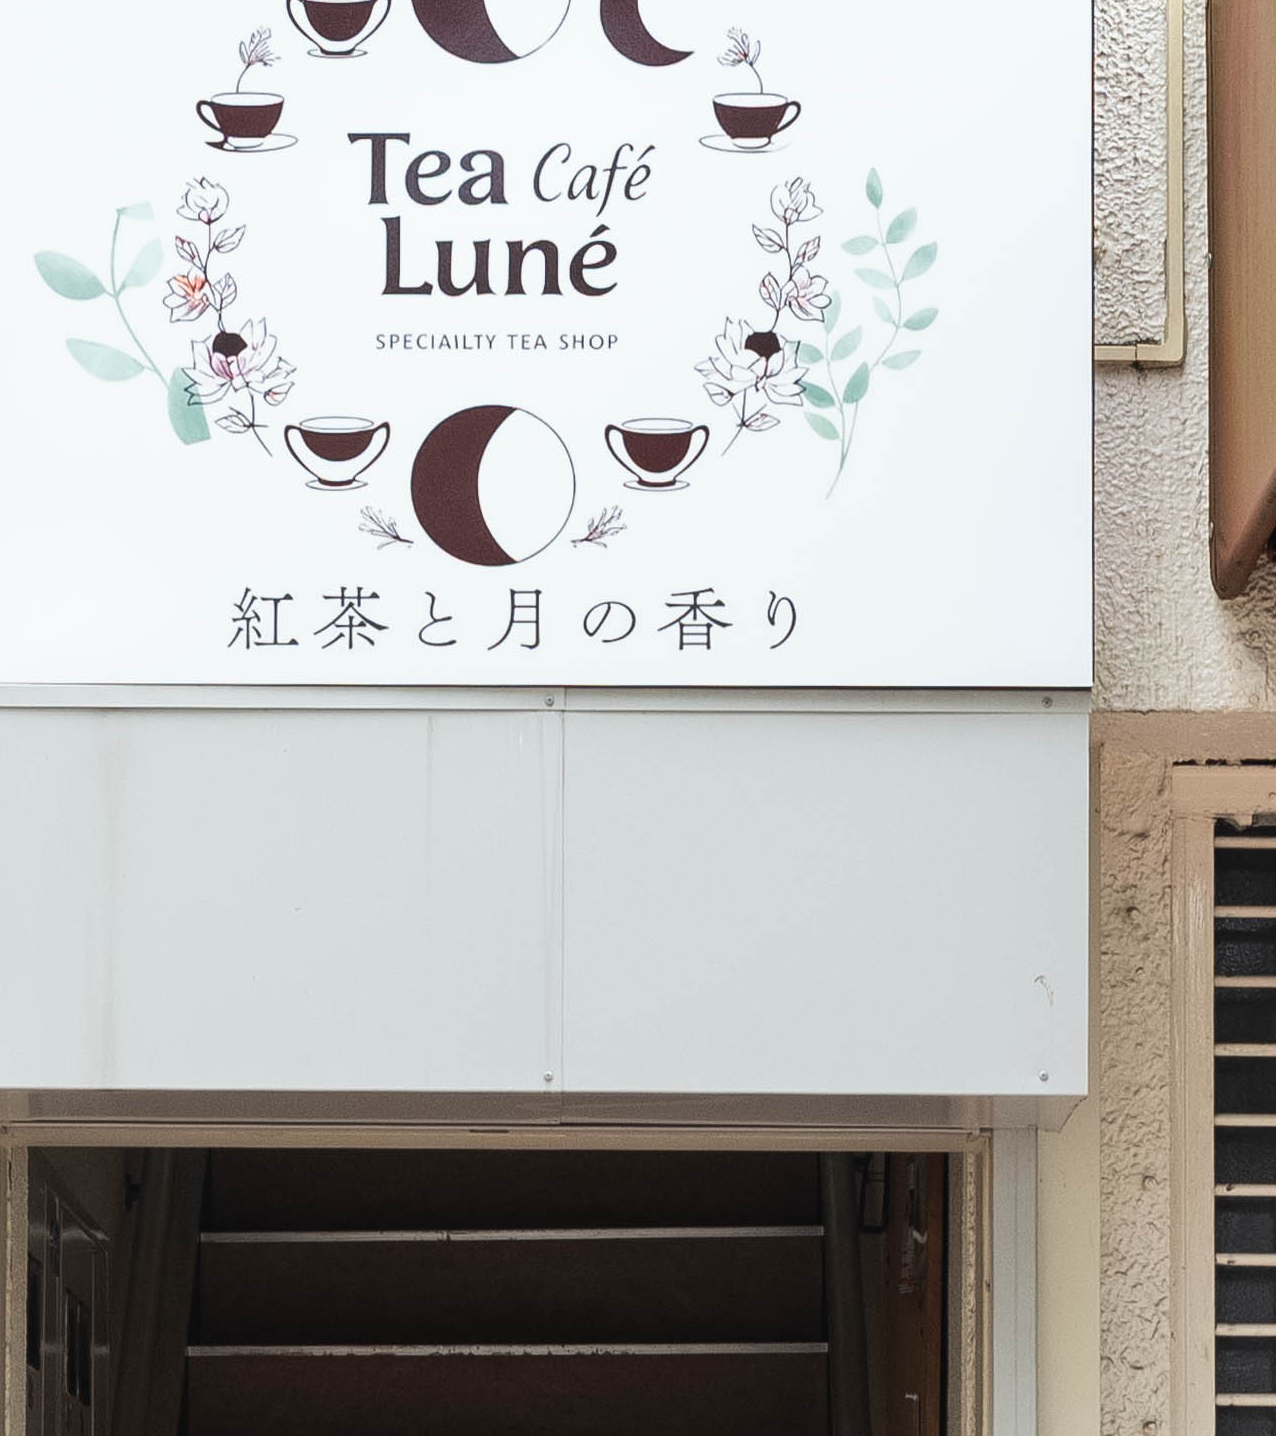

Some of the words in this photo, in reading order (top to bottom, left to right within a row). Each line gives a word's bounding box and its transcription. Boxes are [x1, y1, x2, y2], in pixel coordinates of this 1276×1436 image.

[347, 132, 509, 206] Tea
[533, 142, 656, 218] Café
[380, 215, 618, 297] Luné
[507, 333, 548, 350] TEA
[558, 333, 619, 350] SHOP
[227, 586, 797, 651] 紅茶と月の香り
